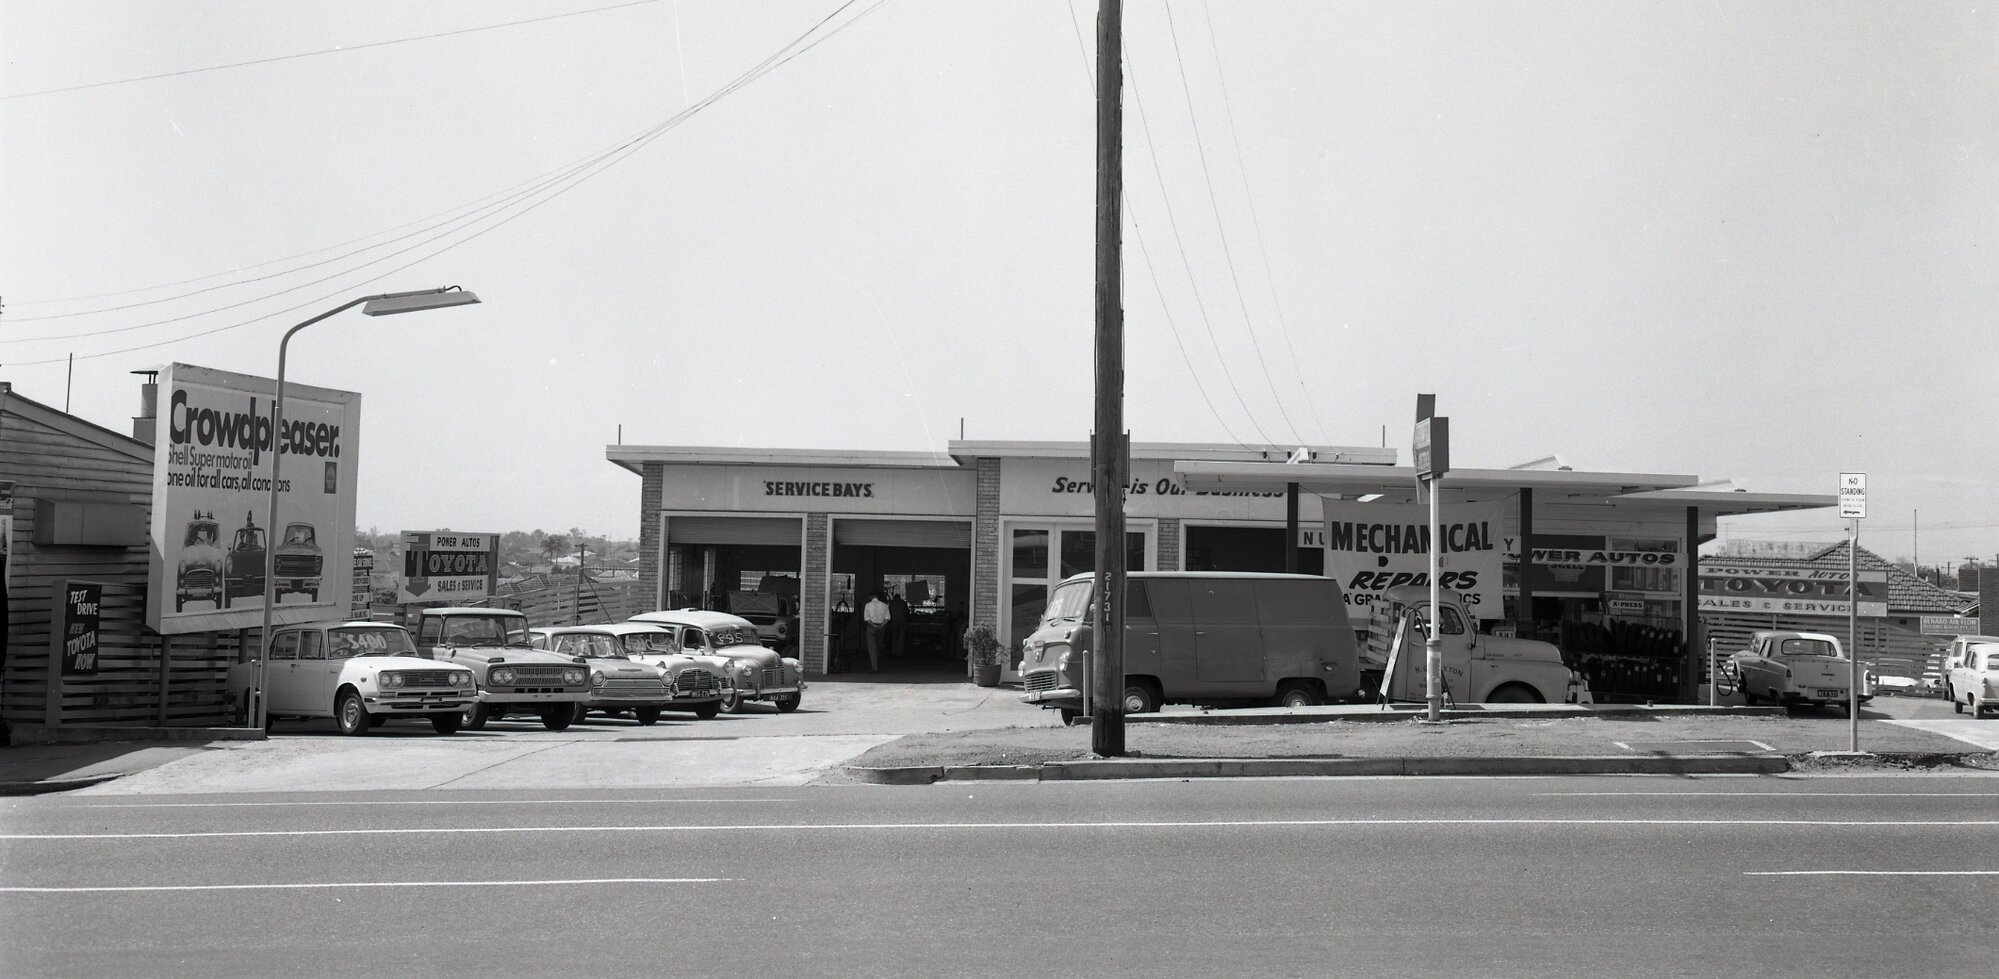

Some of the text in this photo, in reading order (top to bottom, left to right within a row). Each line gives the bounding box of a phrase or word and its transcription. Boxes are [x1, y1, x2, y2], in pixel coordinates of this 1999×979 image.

[170, 389, 340, 466] Crowdpleaser.
[190, 446, 215, 468] Super
[216, 452, 242, 469] motor
[243, 451, 253, 470] oil
[185, 467, 196, 487] oil
[197, 466, 209, 488] for
[210, 469, 221, 488] all
[241, 471, 252, 490] all
[252, 478, 290, 492] condons
[1052, 477, 1094, 493] Serv
[1130, 478, 1148, 494] is
[1849, 477, 1858, 485] NO
[766, 482, 872, 497] SERVICE BAYS
[437, 536, 480, 548] POWER AUTOS
[1331, 521, 1493, 554] MECHANICAL
[411, 550, 488, 579] TOYOTA
[1588, 552, 1676, 565] AUTOS
[1705, 568, 1859, 580] POWER AUTO
[438, 580, 456, 592] SALES
[462, 579, 483, 591] SERVICE
[1700, 577, 1873, 596] TOYOTA
[70, 589, 88, 604] TEST
[1104, 571, 1112, 622] 21731
[1354, 594, 1381, 606] GRA
[1699, 600, 1752, 608] ALES
[77, 603, 98, 615] DRIVE
[67, 630, 96, 656] TOYOTA
[74, 653, 96, 670] NOW
